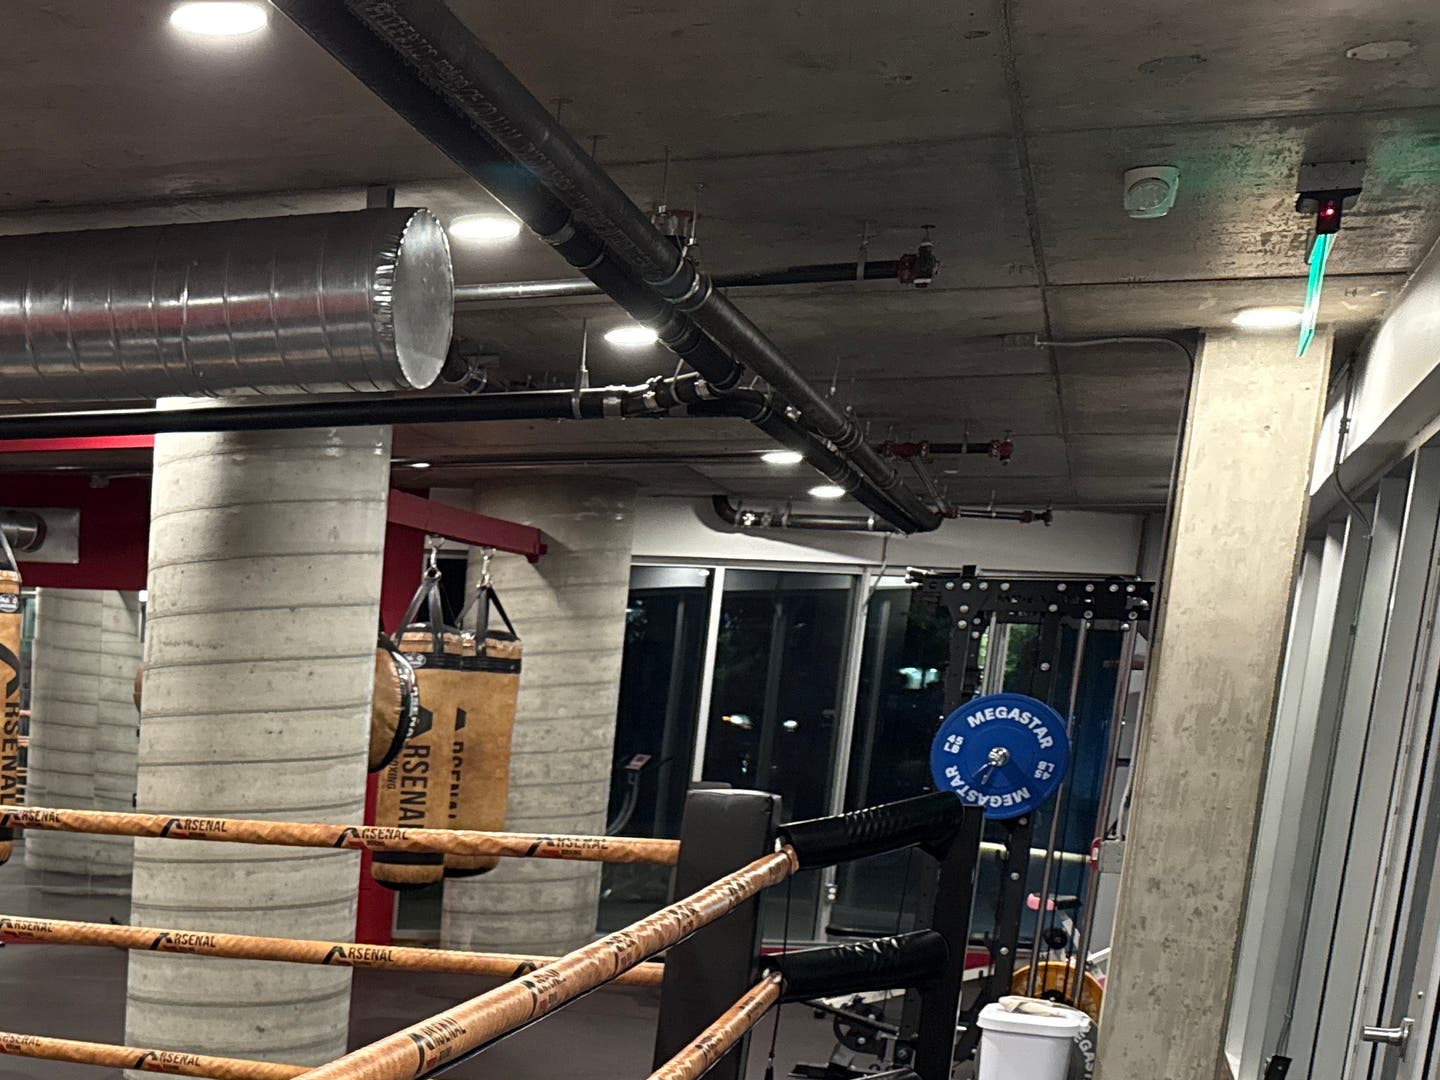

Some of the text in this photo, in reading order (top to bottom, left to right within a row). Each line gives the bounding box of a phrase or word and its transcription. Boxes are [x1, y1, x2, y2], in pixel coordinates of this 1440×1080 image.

[966, 706, 1054, 749] MEGASTAR
[944, 742, 961, 754] LB
[947, 734, 964, 746] 45
[387, 760, 399, 789] OXING
[1034, 769, 1051, 780] 45
[1038, 760, 1055, 772] LB
[945, 765, 1031, 808] MEGASTAR
[160, 818, 228, 838] ARSENAL
[333, 827, 409, 848] ARSENAL
[150, 932, 216, 950] ARSENAL
[322, 946, 394, 965] ARSENAL
